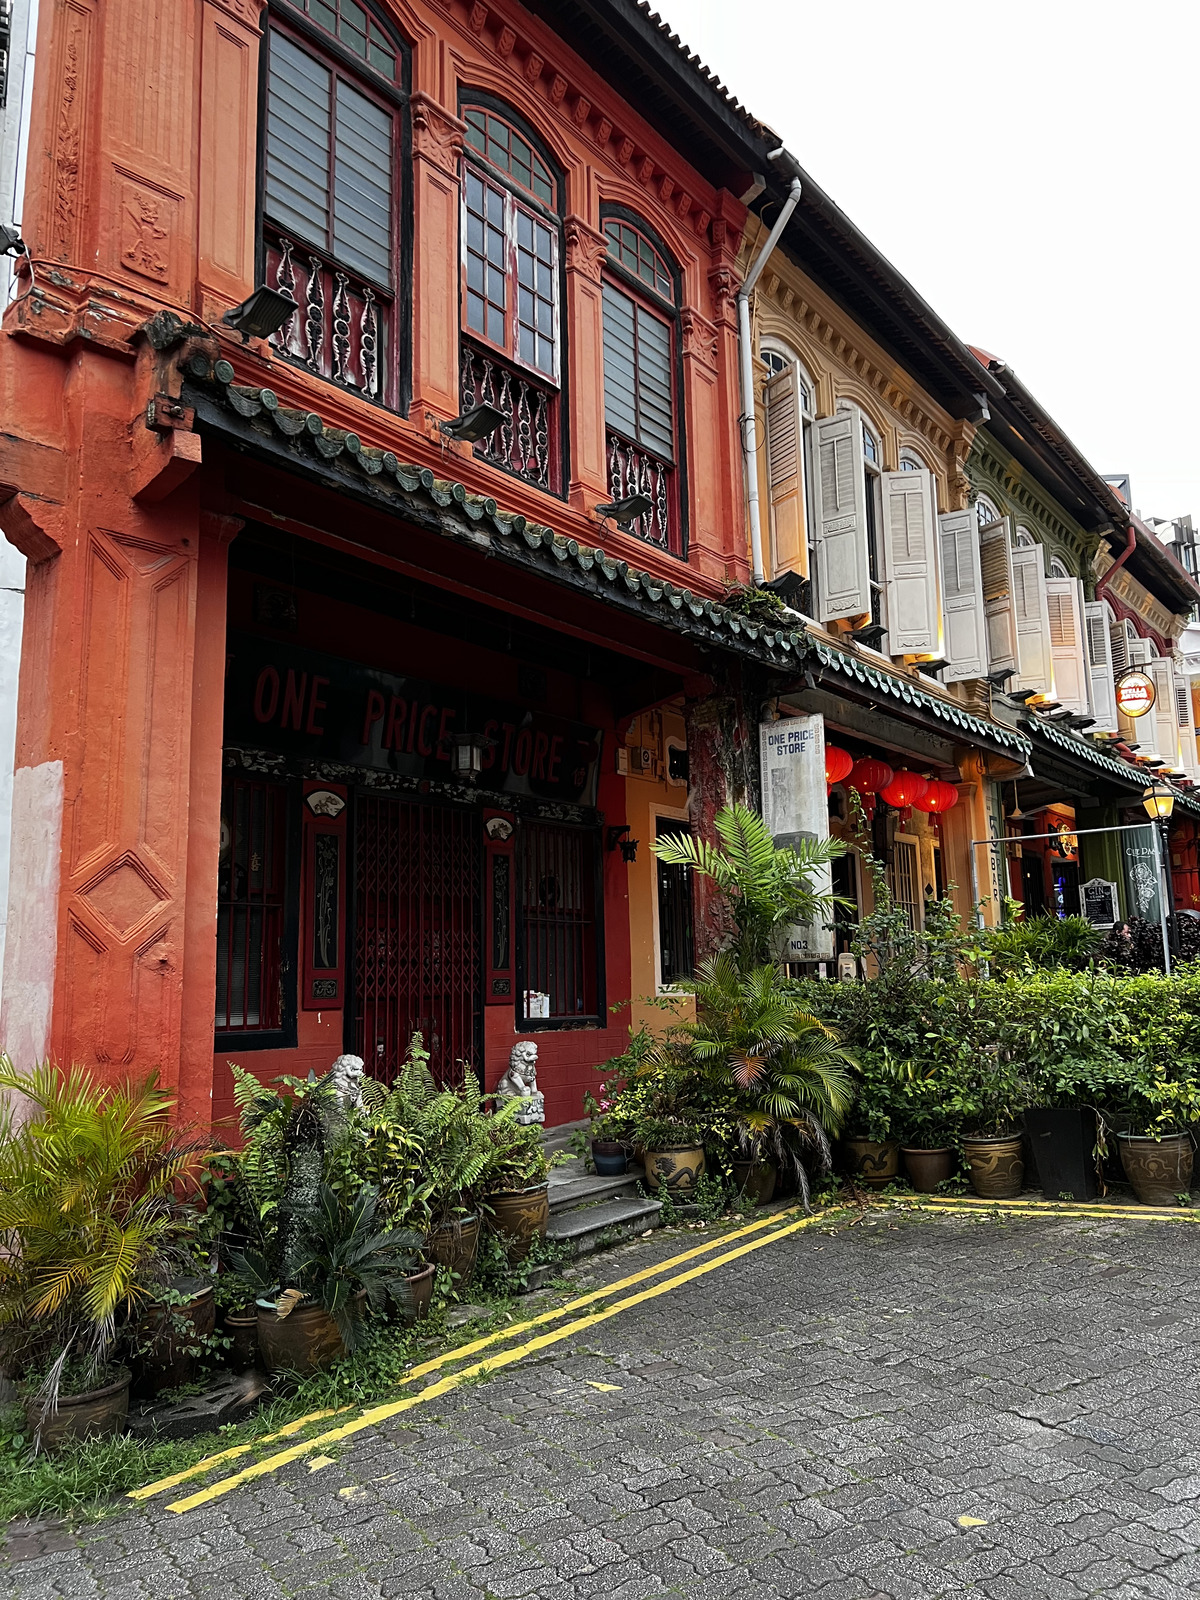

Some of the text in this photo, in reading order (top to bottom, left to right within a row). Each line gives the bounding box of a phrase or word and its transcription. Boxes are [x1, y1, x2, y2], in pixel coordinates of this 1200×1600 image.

[254, 664, 564, 783] ONE PRICE STORE
[768, 729, 814, 746] ONE PRICE
[777, 742, 806, 756] STORE
[991, 857, 999, 902] BAR
[1088, 886, 1104, 897] GIN
